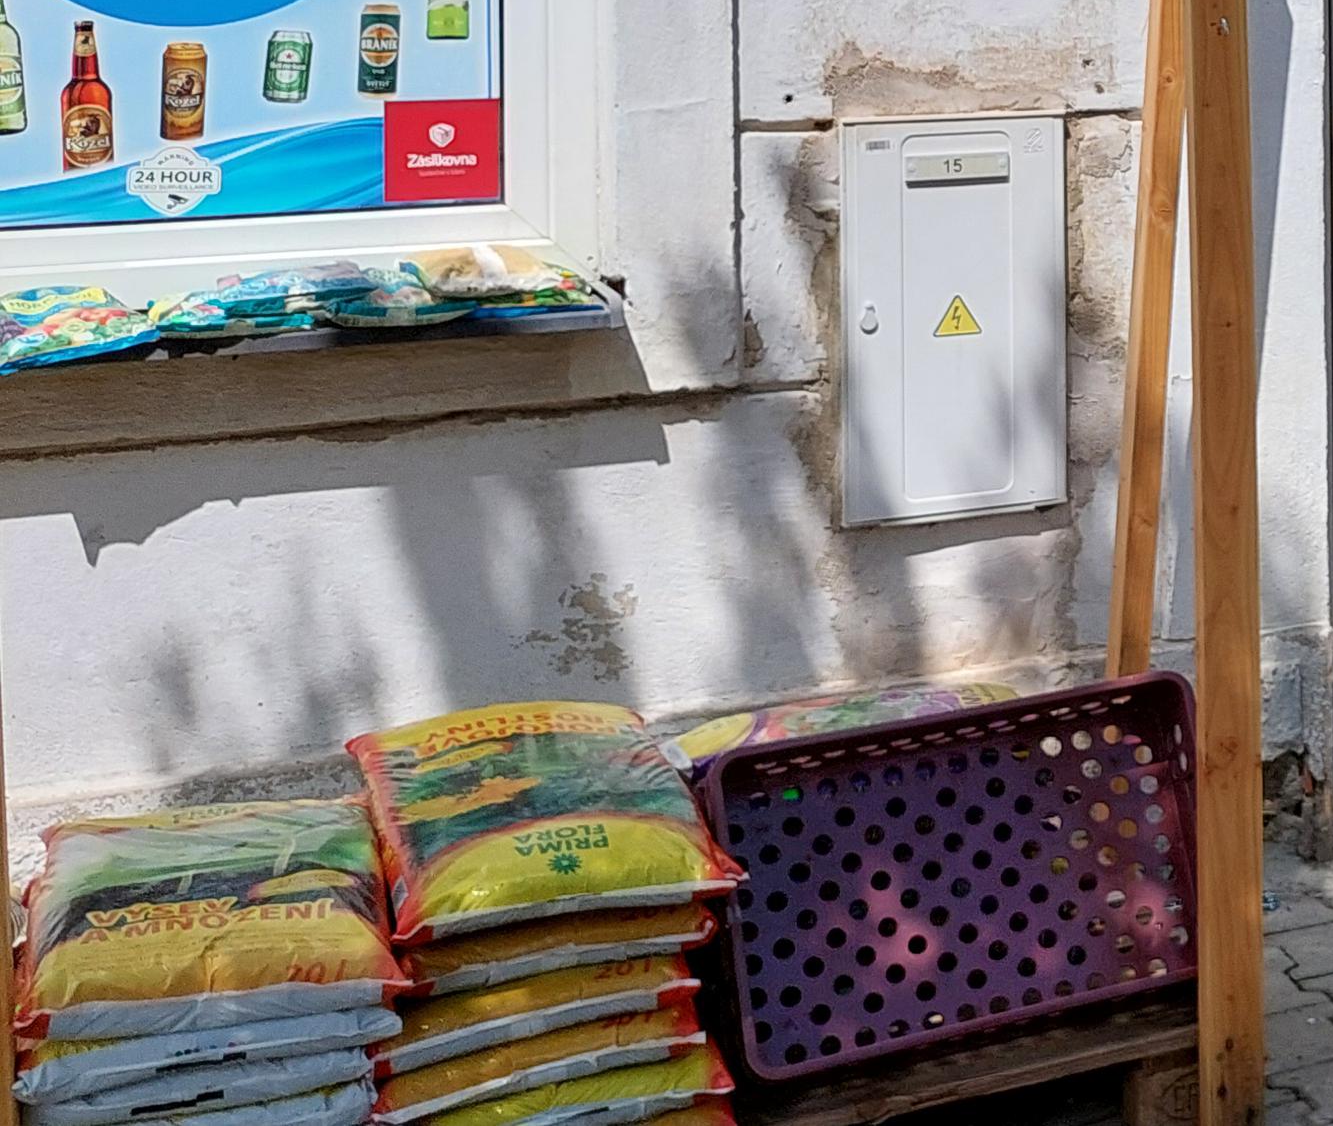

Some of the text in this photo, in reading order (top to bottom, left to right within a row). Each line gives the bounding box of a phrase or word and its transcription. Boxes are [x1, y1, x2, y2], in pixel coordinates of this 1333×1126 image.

[406, 153, 477, 168] Zásilkovna
[944, 158, 962, 173] 15
[135, 171, 213, 183] 24 HOUR
[514, 823, 606, 844] FLORA
[515, 835, 609, 857] PRIMA
[79, 929, 110, 944] A
